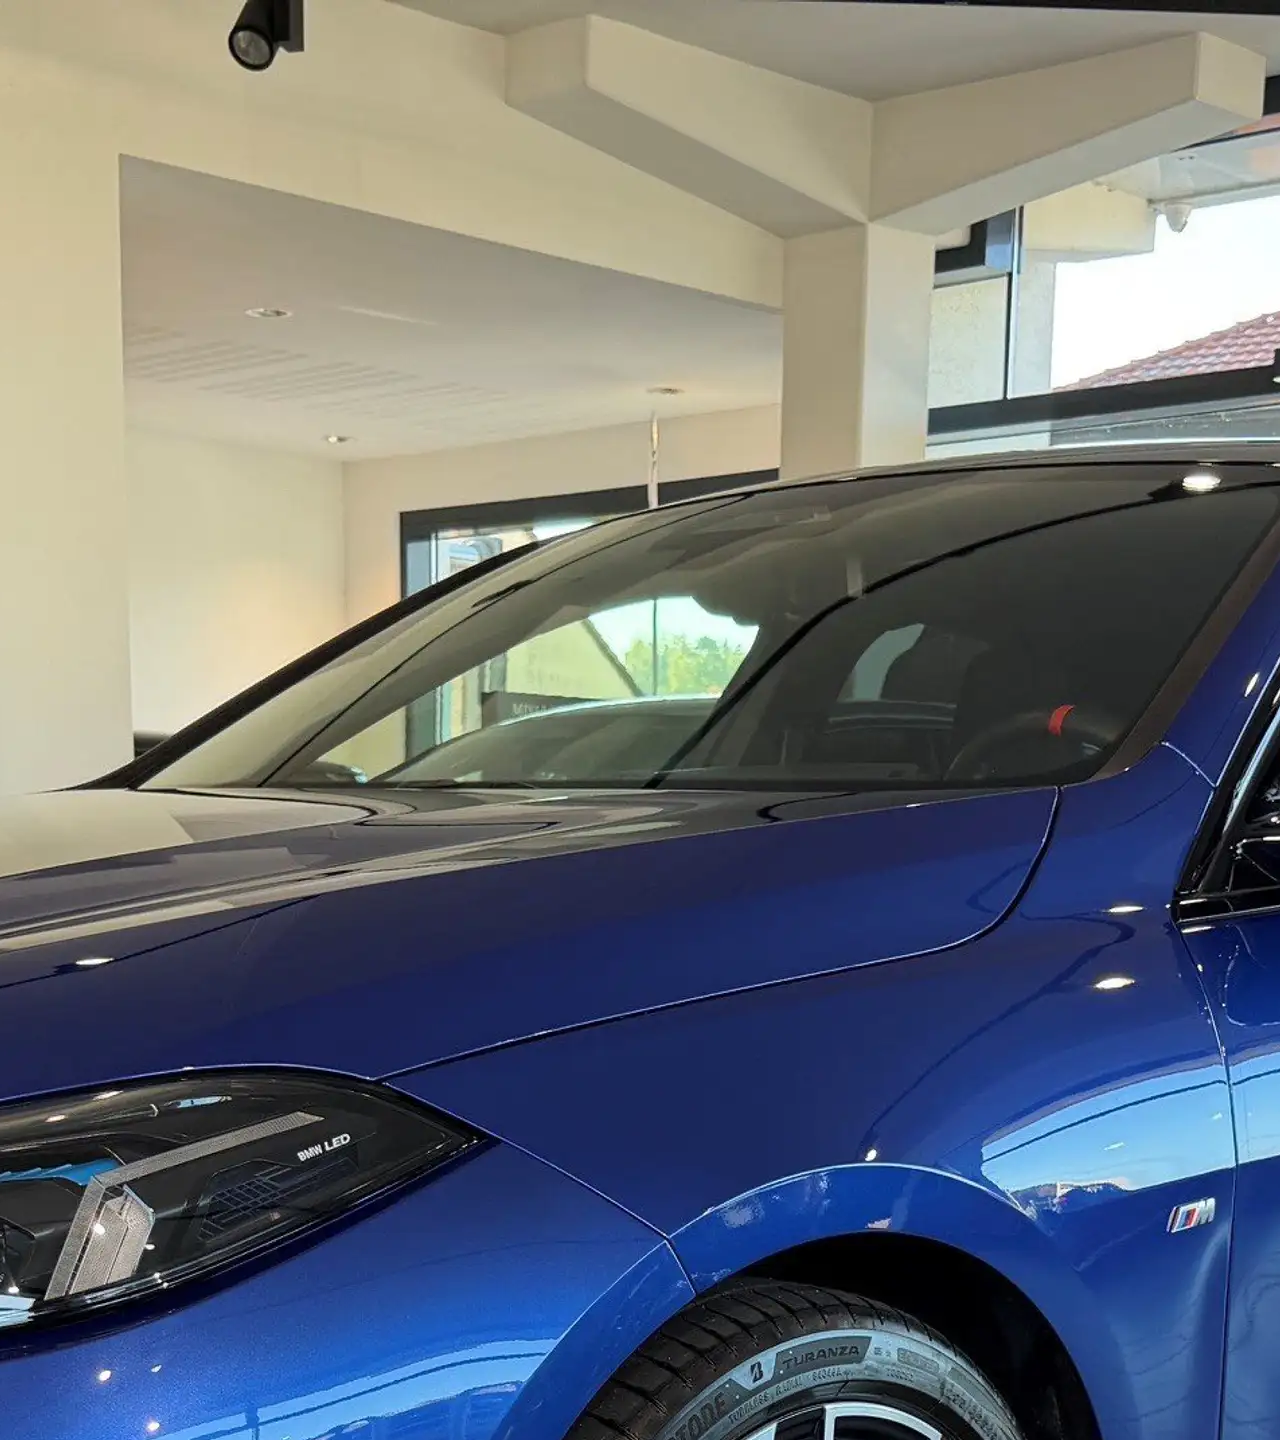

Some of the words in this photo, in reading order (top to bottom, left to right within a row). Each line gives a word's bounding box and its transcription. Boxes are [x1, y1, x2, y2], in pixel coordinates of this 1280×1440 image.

[297, 1143, 323, 1161] BMW
[324, 1133, 351, 1151] LED
[782, 1345, 859, 1370] TURANZA
